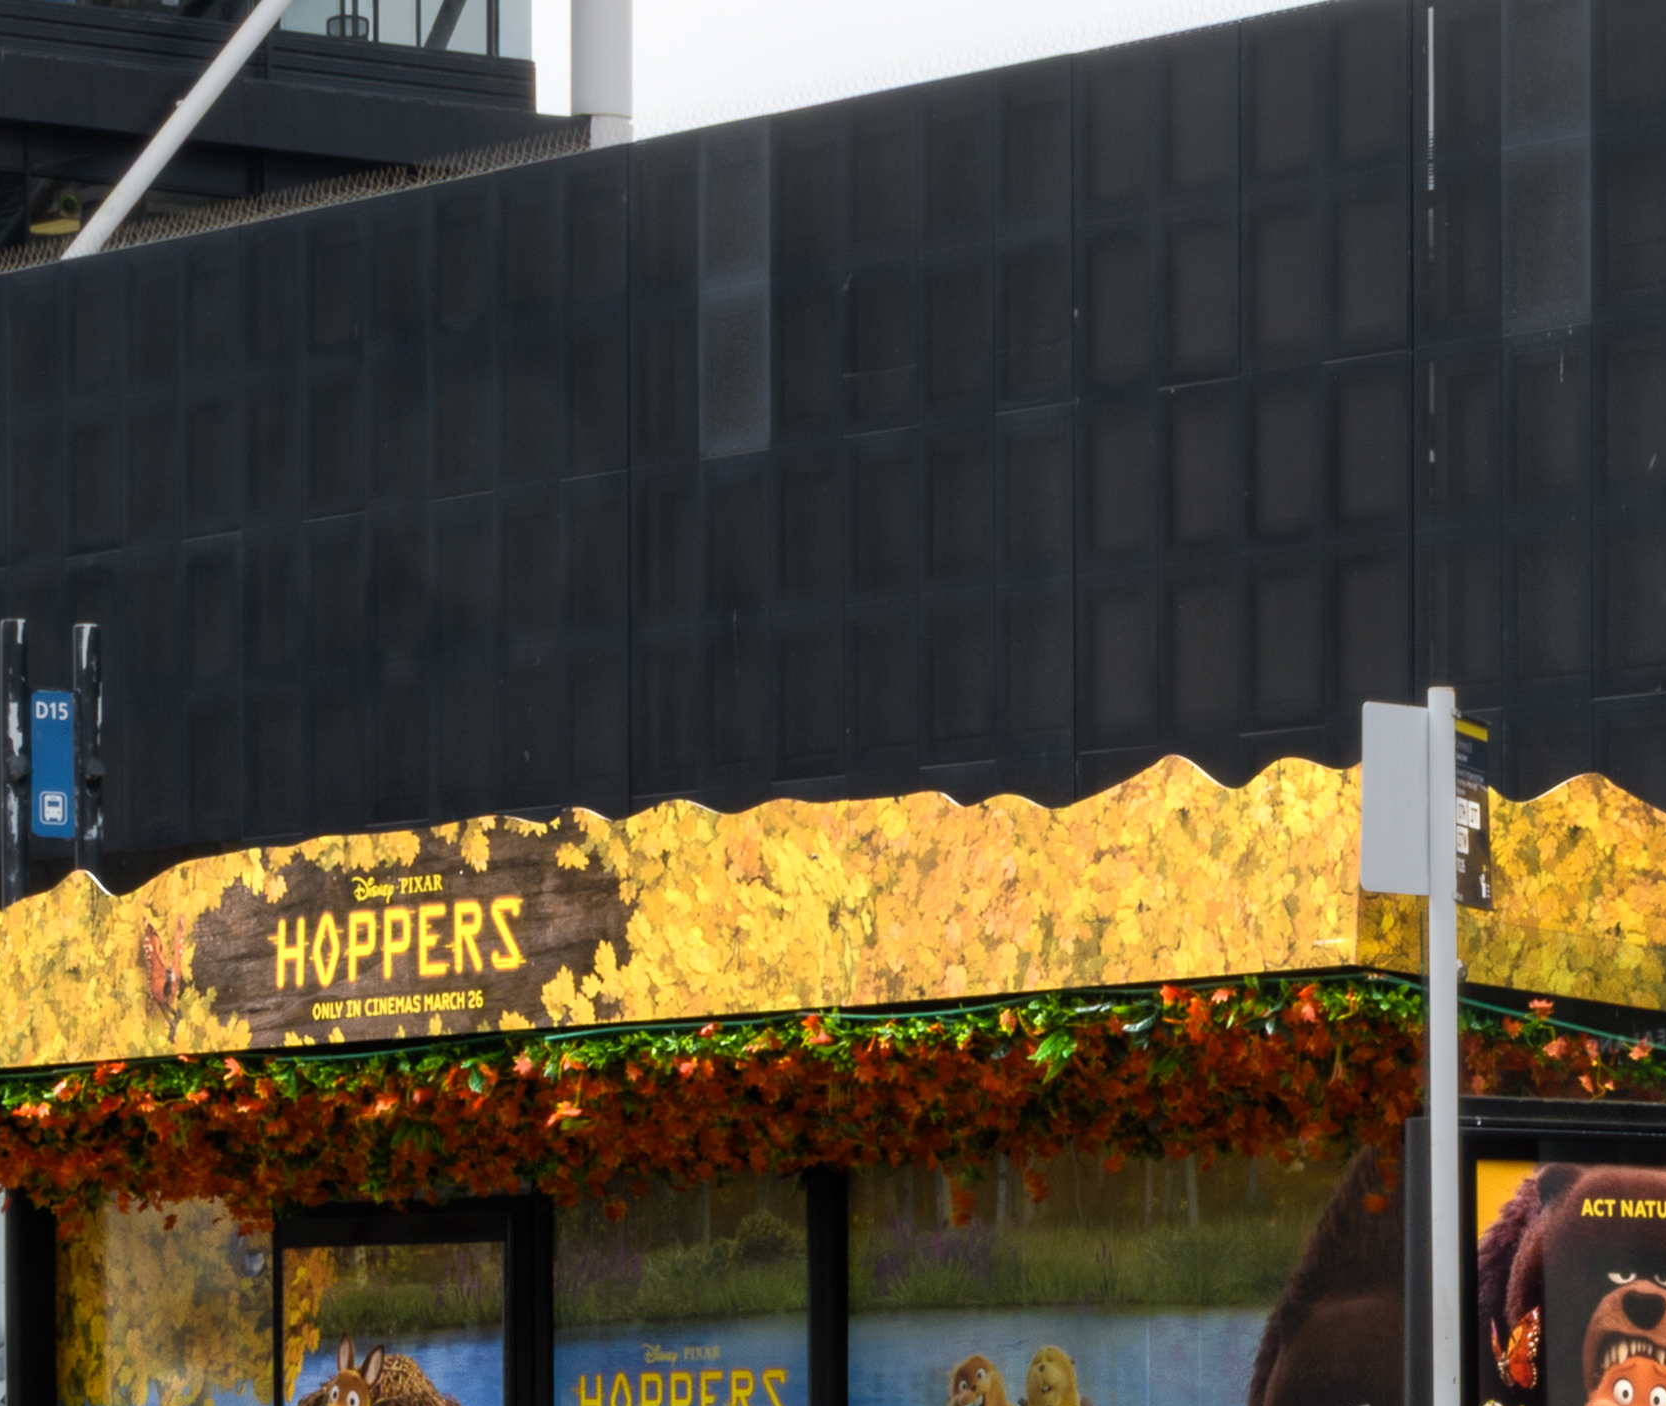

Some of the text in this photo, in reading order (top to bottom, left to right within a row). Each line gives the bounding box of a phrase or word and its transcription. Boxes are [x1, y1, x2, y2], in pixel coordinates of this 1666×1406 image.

[35, 701, 69, 720] D15
[400, 874, 443, 894] PIXAR
[273, 896, 525, 989] HOPPERS
[312, 990, 484, 1020] ONLY IN CINEMAS MARCH 26
[1581, 1199, 1616, 1217] ACT
[684, 1346, 721, 1361] PIXAR
